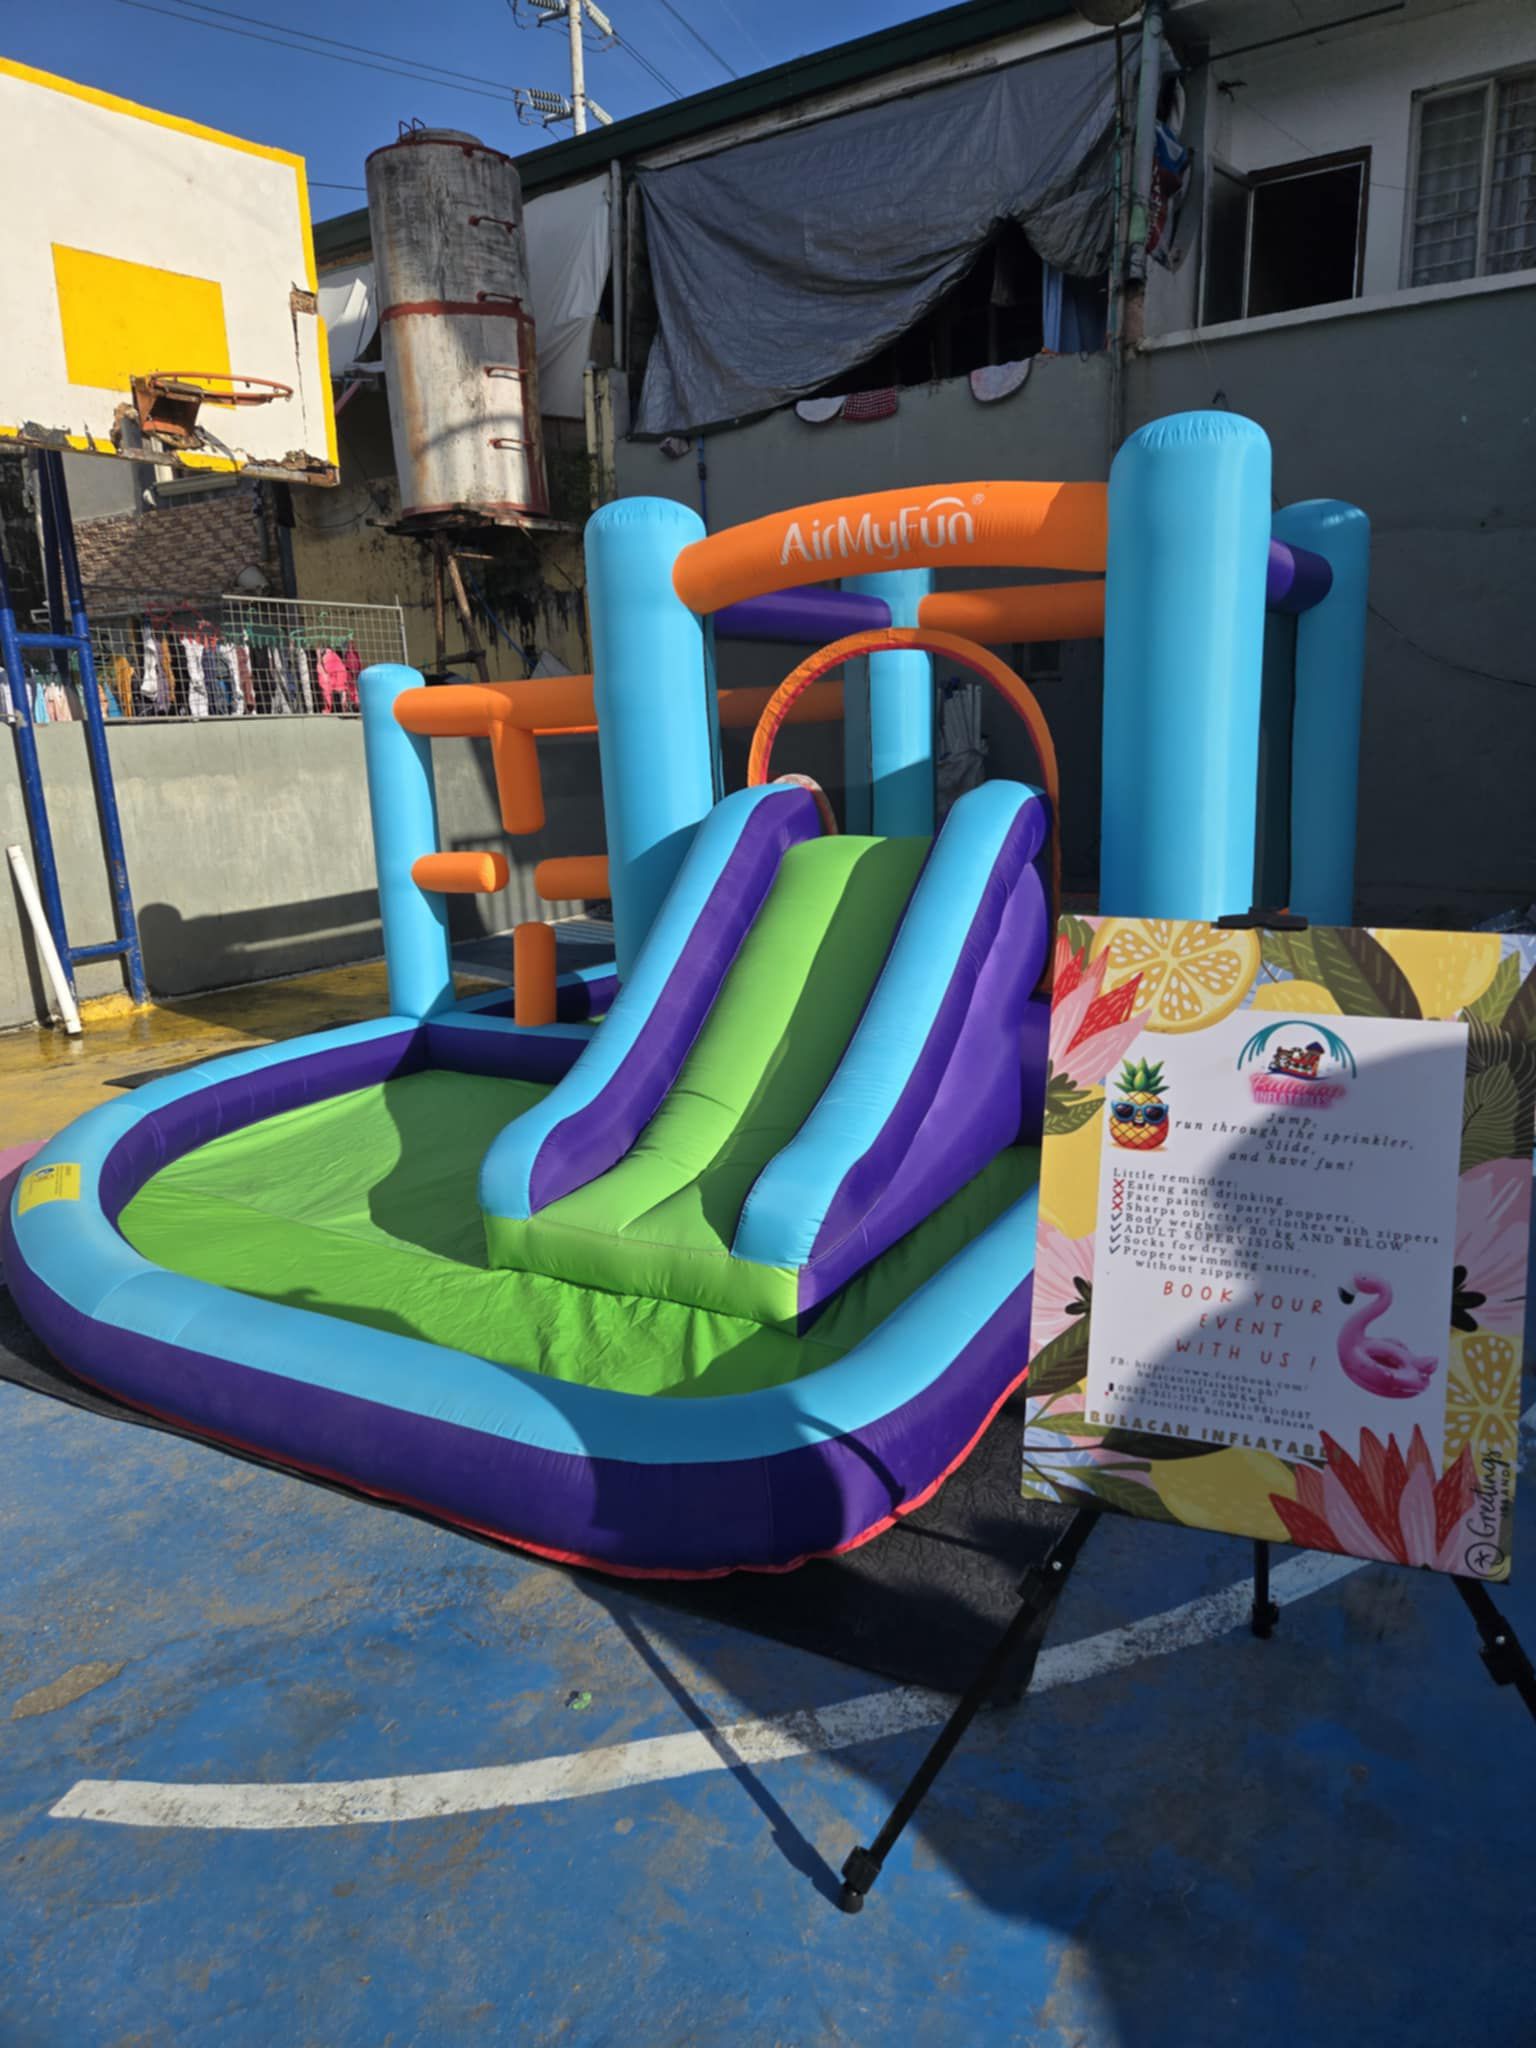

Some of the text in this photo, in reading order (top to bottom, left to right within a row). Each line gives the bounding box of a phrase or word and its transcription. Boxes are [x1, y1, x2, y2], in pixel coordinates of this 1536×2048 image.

[780, 496, 975, 565] AirMyFun
[1175, 1120, 1203, 1131] run
[1211, 1121, 1279, 1139] through
[1288, 1127, 1315, 1141] the
[1228, 1151, 1260, 1162] and
[1268, 1153, 1308, 1167] have
[1113, 1168, 1154, 1180] Little
[1127, 1180, 1175, 1195] Eating
[1182, 1187, 1208, 1197] and
[1127, 1190, 1159, 1203] Face
[1166, 1197, 1206, 1208] paint
[1235, 1203, 1278, 1216] party
[1124, 1224, 1177, 1238] ADULT
[1125, 1212, 1162, 1227] Body
[1169, 1219, 1219, 1232] weight
[1300, 1231, 1335, 1244] AND
[1182, 1208, 1237, 1222] objects
[1268, 1218, 1326, 1232] clothes
[1334, 1225, 1369, 1237] with
[1376, 1230, 1439, 1244] zippers
[1123, 1234, 1165, 1248] Socks
[1172, 1240, 1195, 1251] for
[1202, 1243, 1228, 1256] dry
[1124, 1245, 1174, 1262] Proper
[1181, 1253, 1258, 1271] swimming
[1136, 1260, 1193, 1274] without
[1163, 1281, 1323, 1316] BOOK YOUR
[1199, 1313, 1284, 1339] EVENT
[1176, 1338, 1241, 1360] WITH
[1260, 1351, 1290, 1368] US
[1090, 1410, 1190, 1438] BULACAN
